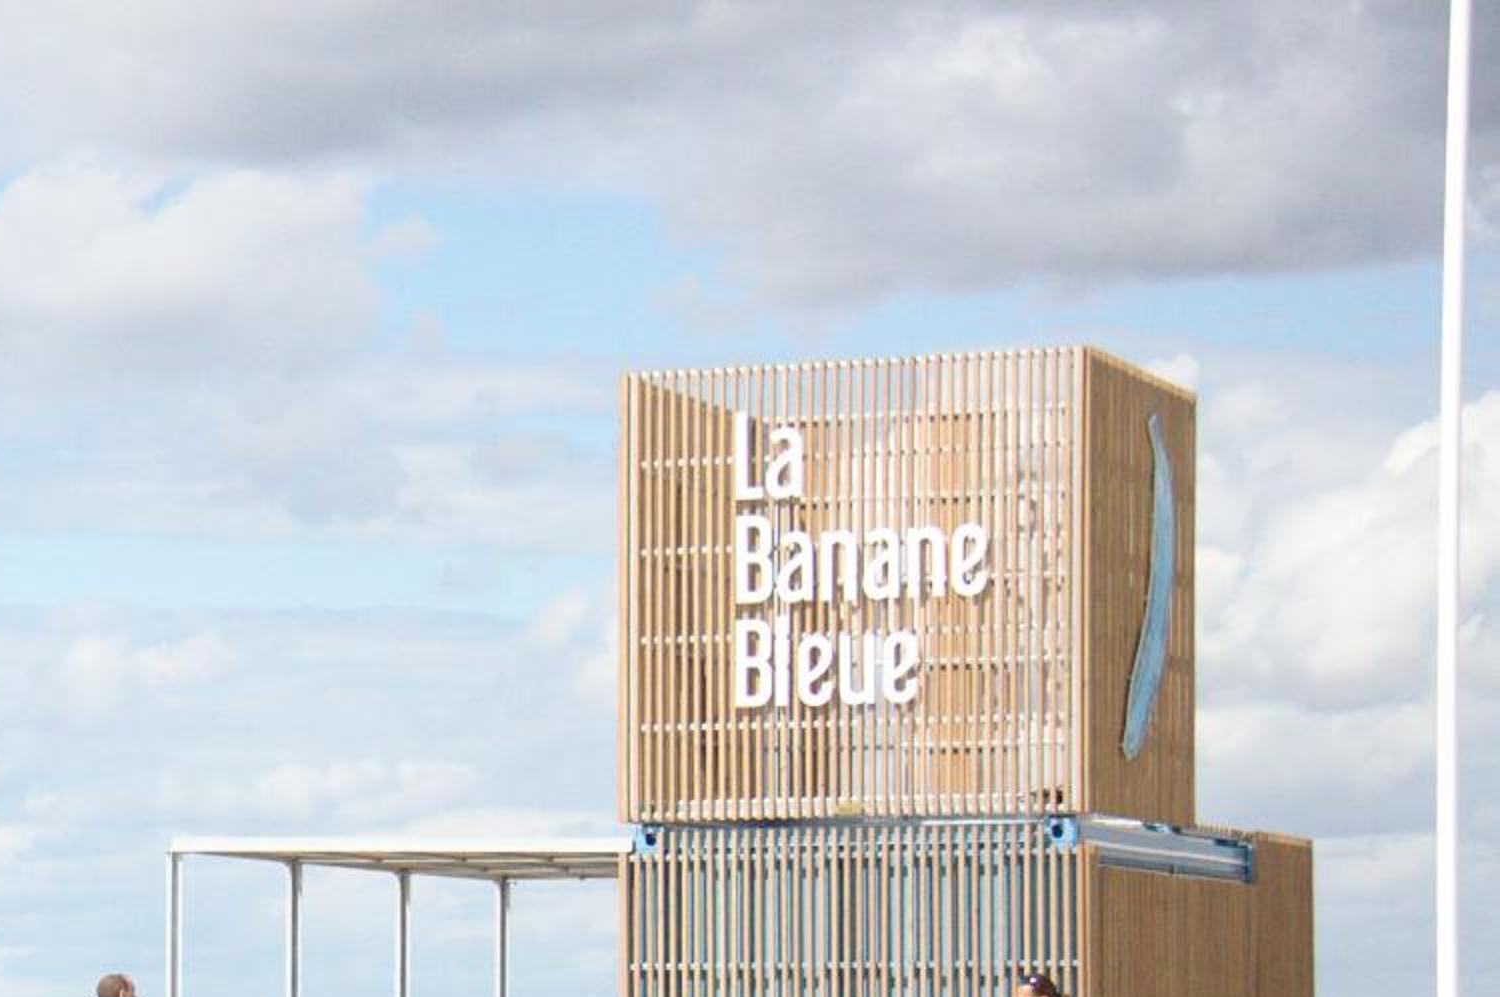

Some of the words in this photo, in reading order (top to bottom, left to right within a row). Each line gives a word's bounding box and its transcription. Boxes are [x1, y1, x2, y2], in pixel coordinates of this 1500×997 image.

[735, 411, 804, 500] La
[735, 514, 988, 604] Banane
[735, 615, 919, 707] Bleue
